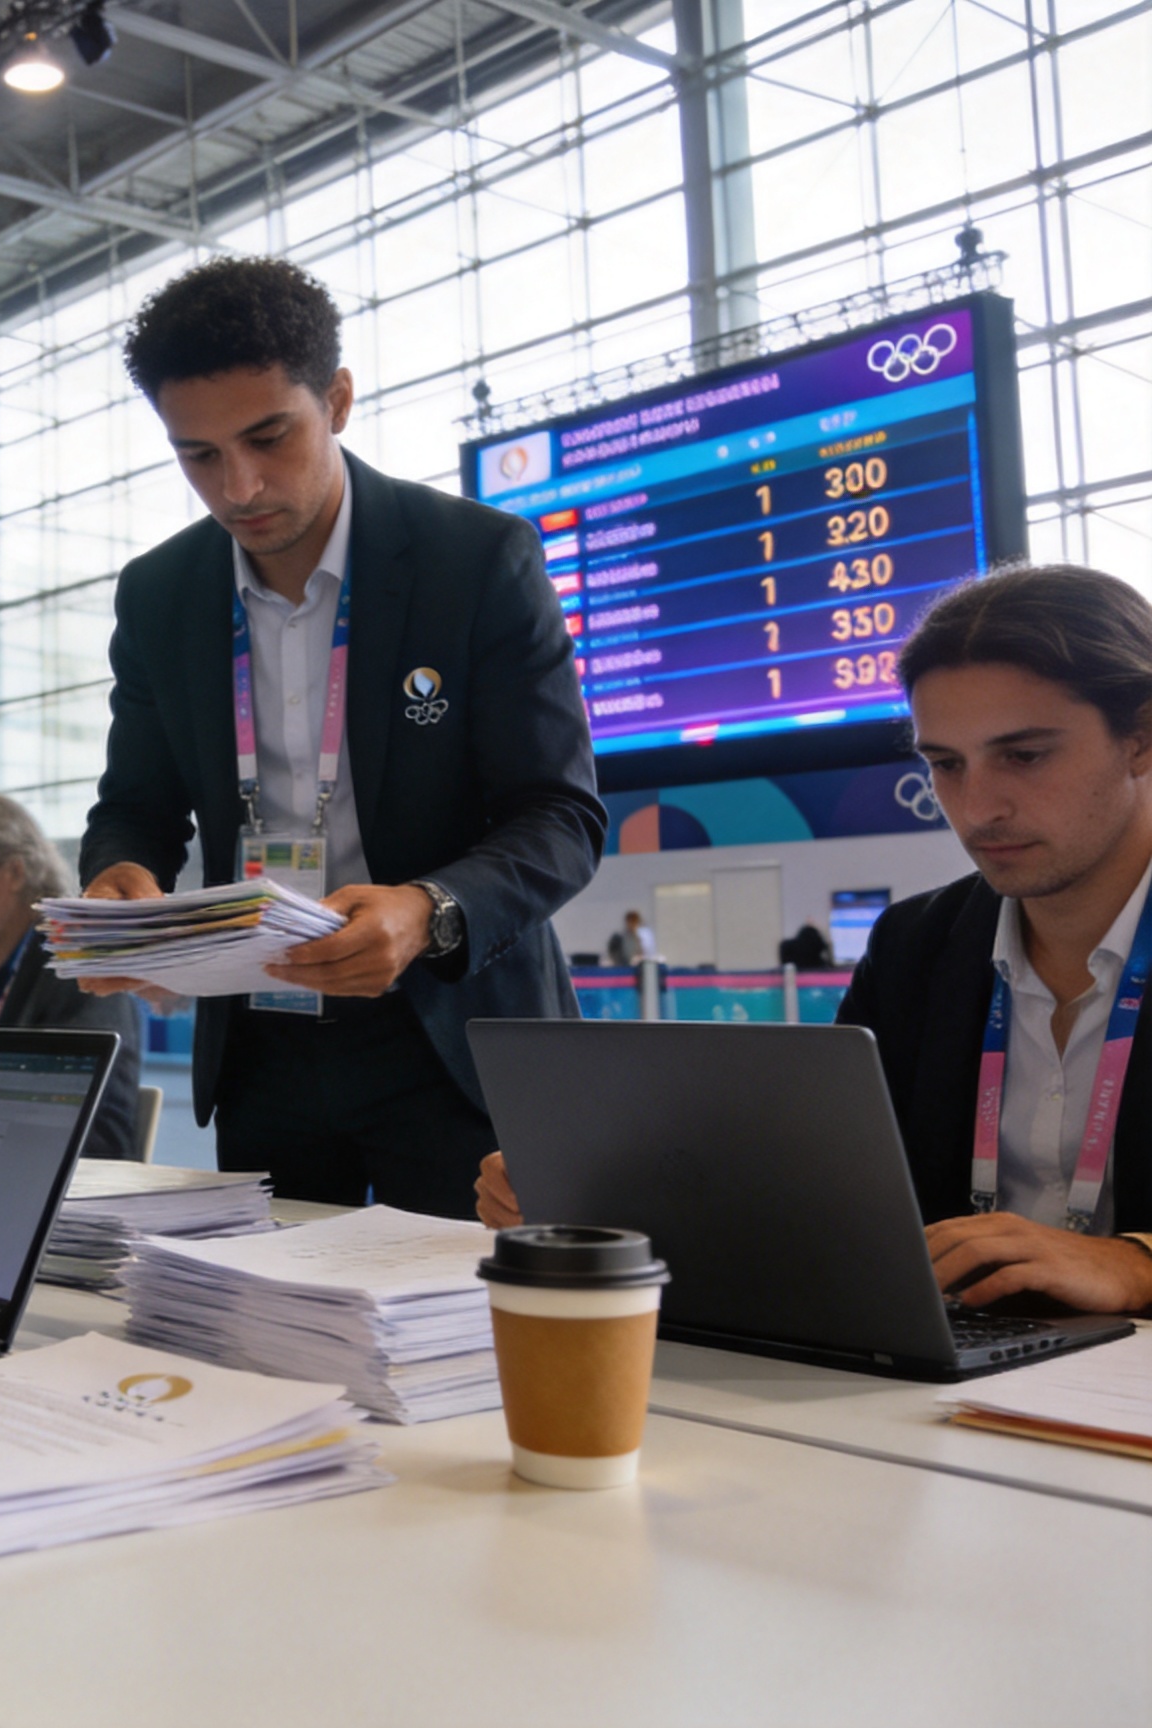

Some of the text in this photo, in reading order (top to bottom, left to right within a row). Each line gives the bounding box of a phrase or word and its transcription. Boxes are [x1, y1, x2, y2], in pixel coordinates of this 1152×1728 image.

[755, 457, 888, 515] 1 300
[758, 506, 890, 562] 1 320
[760, 553, 894, 606] 1 430
[766, 668, 782, 699] 1
